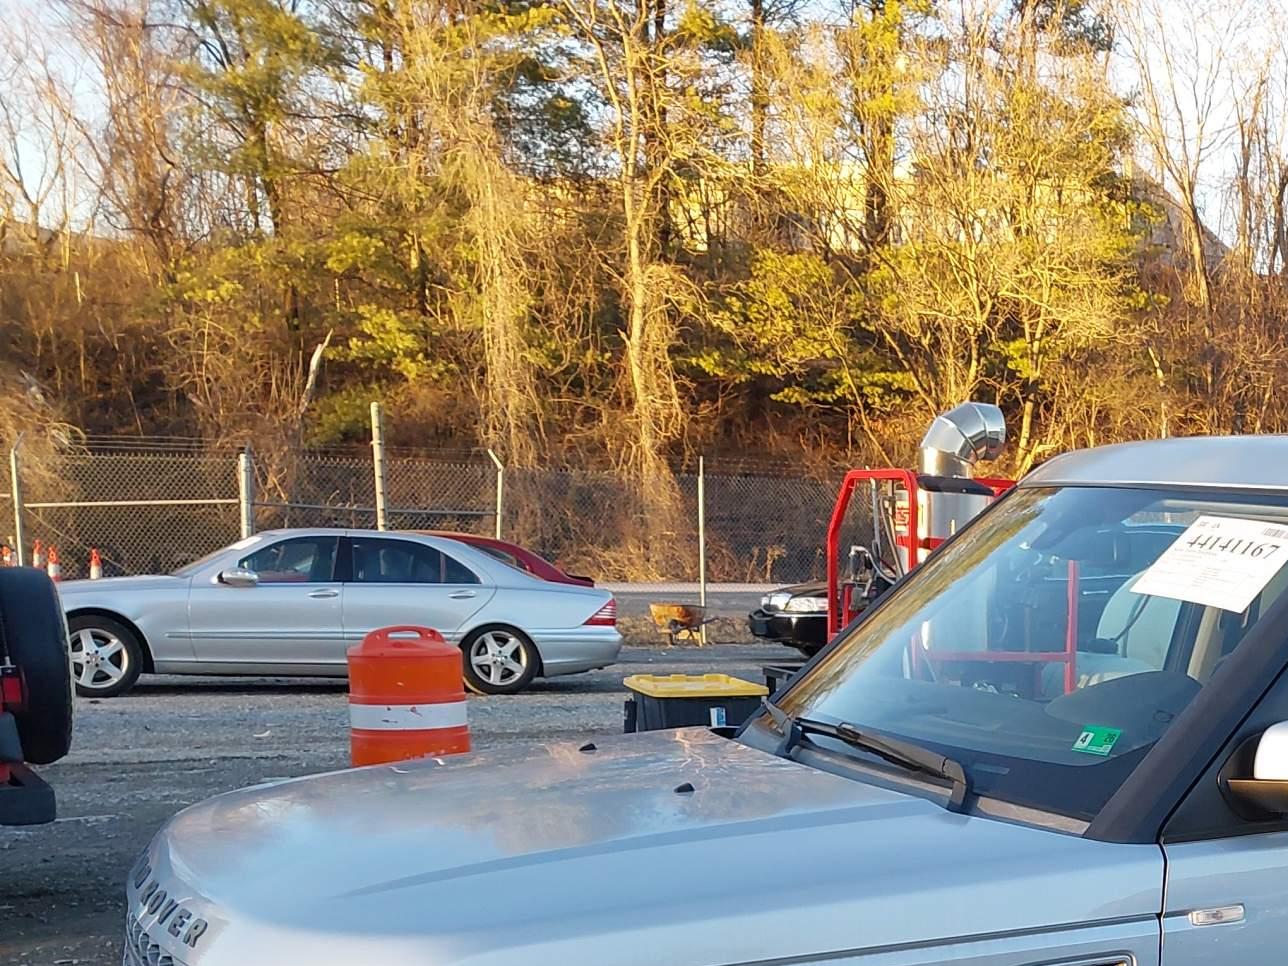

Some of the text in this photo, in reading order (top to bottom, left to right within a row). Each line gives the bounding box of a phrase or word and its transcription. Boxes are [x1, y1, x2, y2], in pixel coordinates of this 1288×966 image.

[1187, 533, 1281, 559] 44141167
[1080, 733, 1090, 744] 4
[140, 880, 208, 948] ROVER
